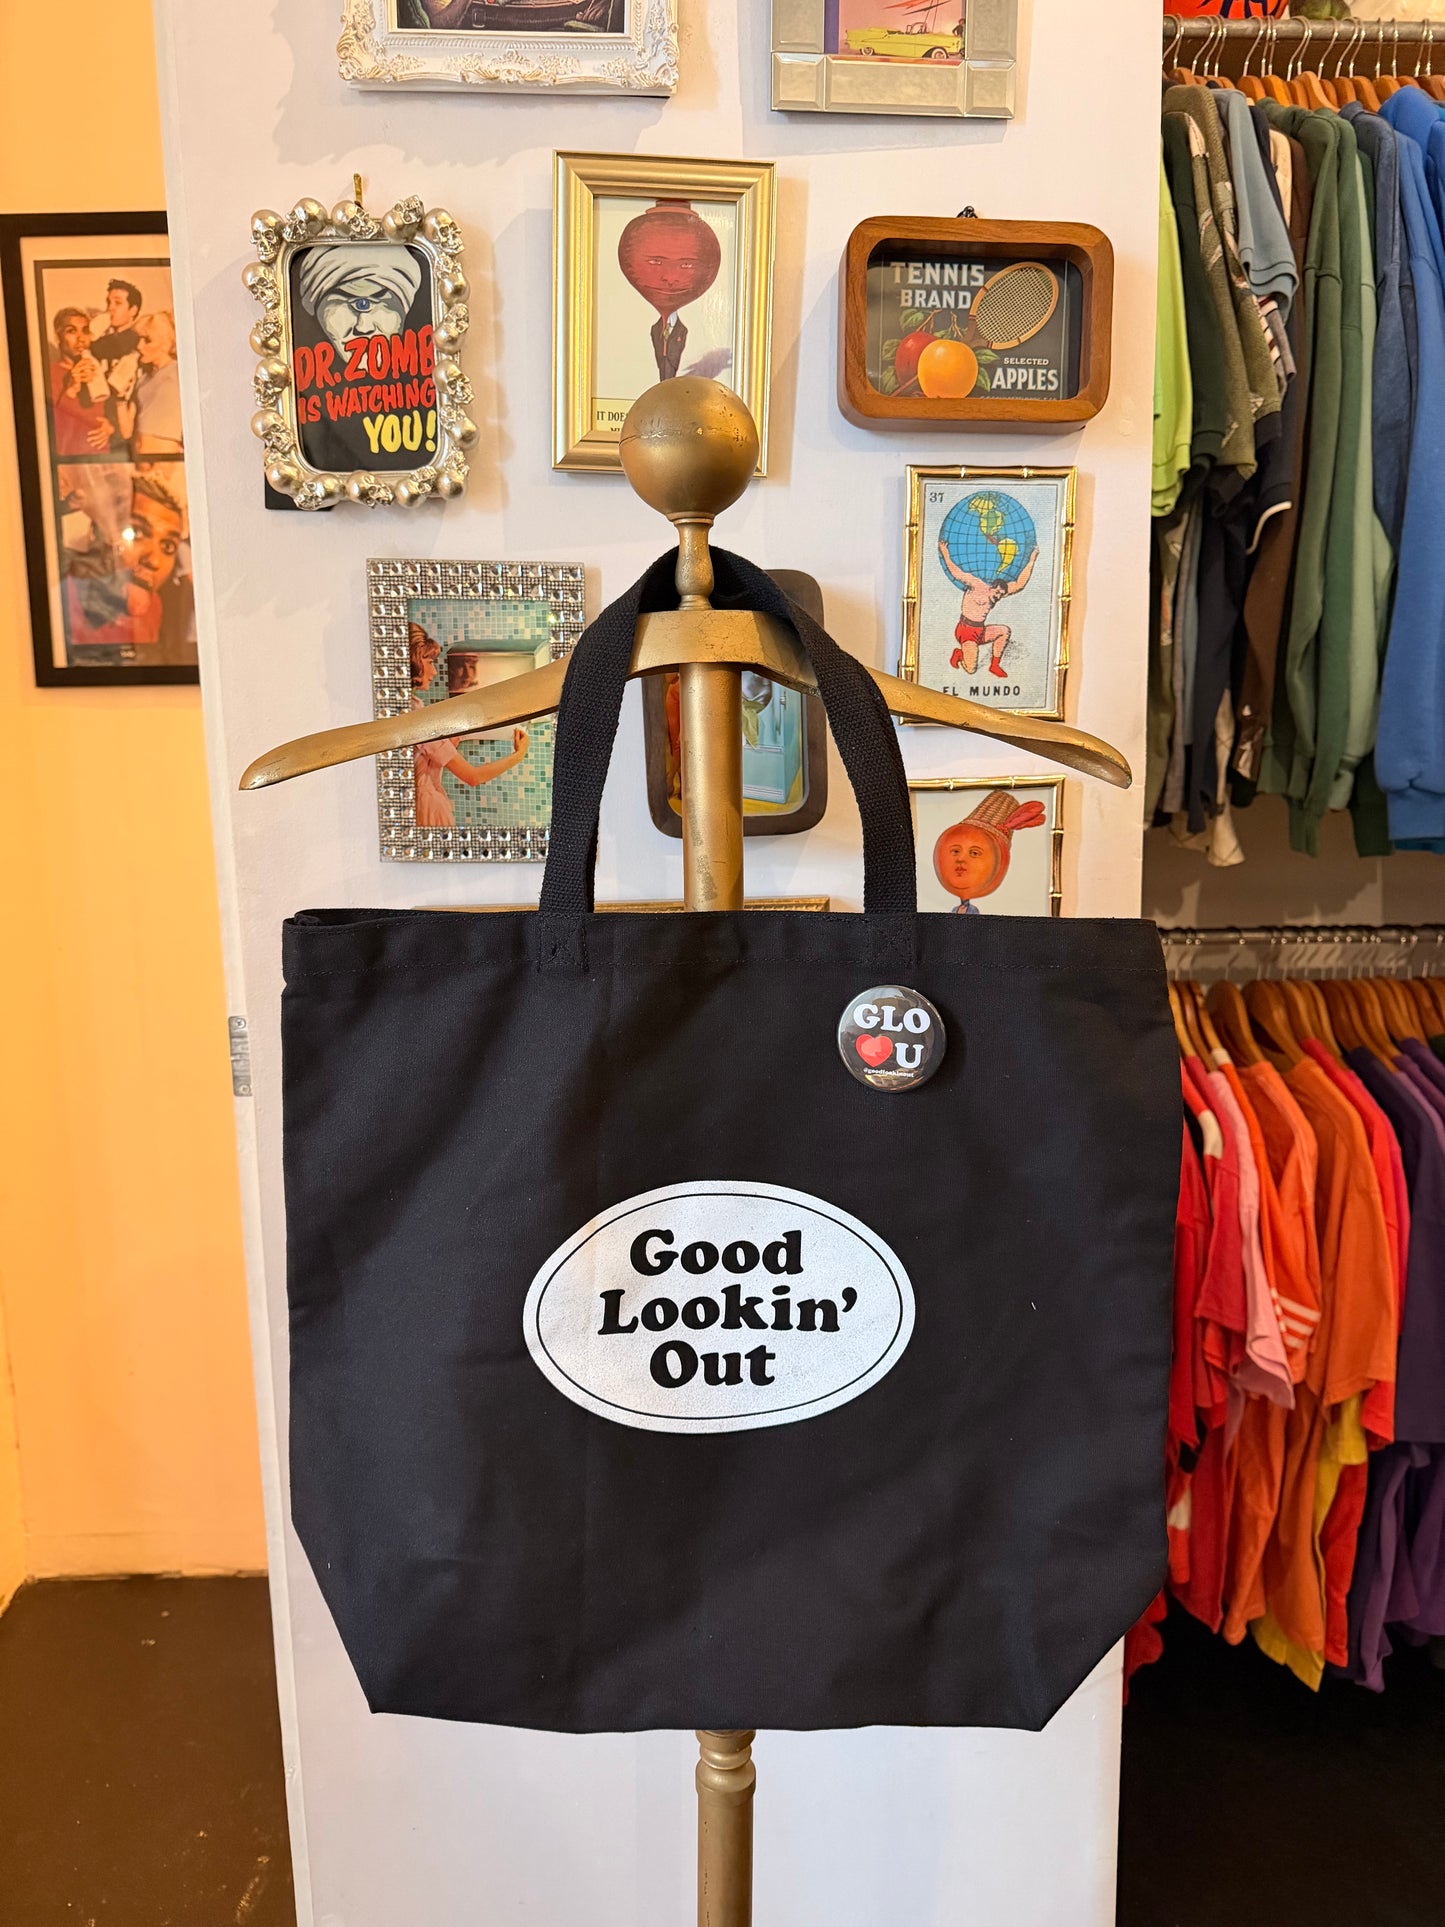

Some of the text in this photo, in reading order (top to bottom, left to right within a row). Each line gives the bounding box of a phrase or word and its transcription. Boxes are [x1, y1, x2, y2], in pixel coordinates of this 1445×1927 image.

[890, 262, 985, 287] TENNIS
[901, 289, 972, 310] BRAND
[294, 324, 435, 392] DR. ZOMB
[1003, 357, 1049, 366] SELECTED
[991, 367, 1059, 392] APPLES
[298, 378, 436, 424] IS WATCHING
[596, 410, 628, 422] IT DOE
[363, 410, 437, 454] YOU!
[929, 492, 945, 503] 37
[969, 685, 1021, 697] MUNDO
[853, 1003, 931, 1034] GLO
[894, 1042, 924, 1069] U
[630, 1229, 804, 1277] Good
[597, 1284, 858, 1336] Lookin’
[649, 1340, 776, 1389] Out
